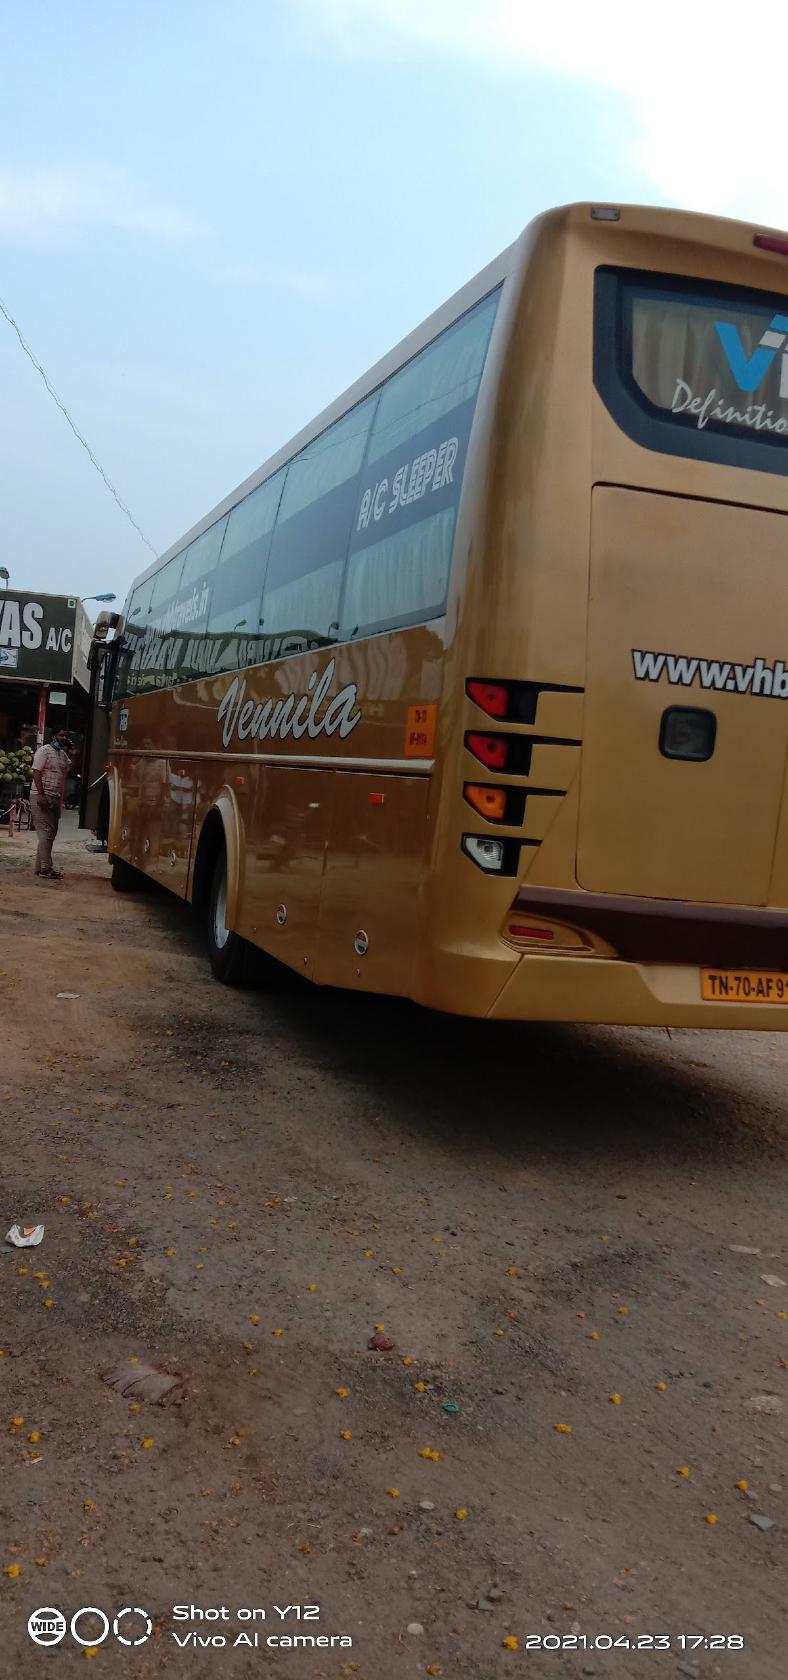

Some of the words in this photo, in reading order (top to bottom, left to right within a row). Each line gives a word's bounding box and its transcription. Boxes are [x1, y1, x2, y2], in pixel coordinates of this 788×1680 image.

[671, 378, 788, 433] Definitio
[357, 478, 388, 531] A/C
[389, 437, 458, 514] SLEEPER
[0, 600, 44, 650] AS
[46, 627, 73, 653] A/C
[217, 657, 362, 747] Vennila
